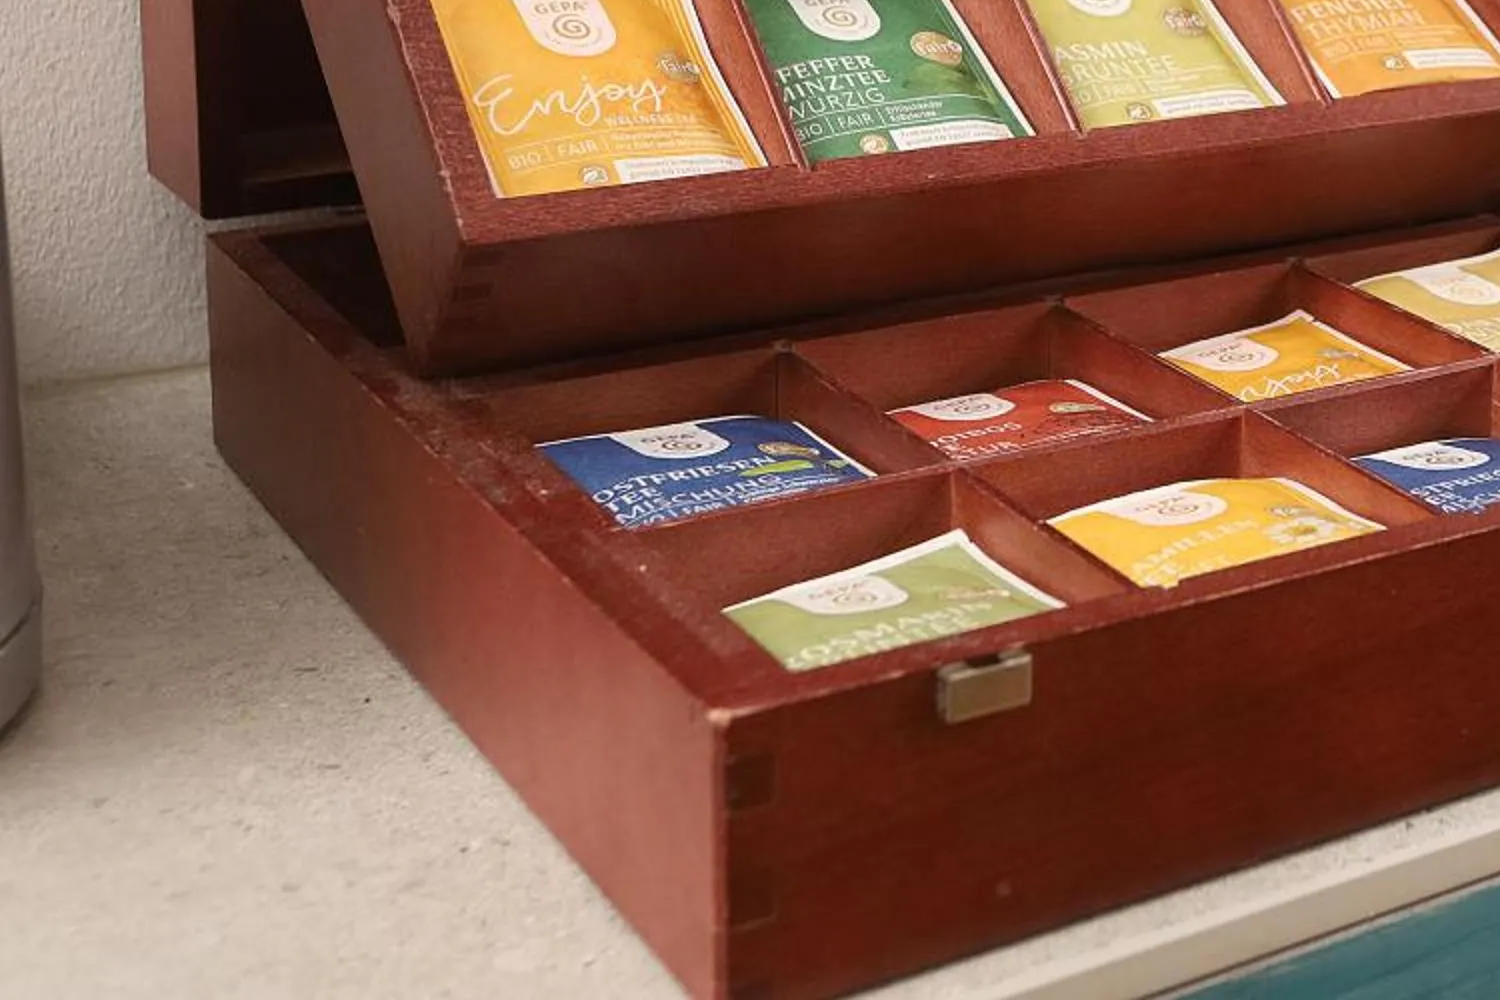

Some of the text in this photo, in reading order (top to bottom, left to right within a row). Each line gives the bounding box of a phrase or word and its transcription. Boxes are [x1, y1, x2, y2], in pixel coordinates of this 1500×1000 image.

[534, 0, 585, 16] GEPA
[1305, 9, 1427, 41] THYMIAN
[472, 73, 668, 137] Enjoy
[837, 113, 874, 130] FAIR
[508, 152, 542, 171] BIO
[557, 140, 599, 158] FAIR
[592, 454, 777, 504] OSTFRIESEN
[615, 473, 782, 525] MISCHUNG
